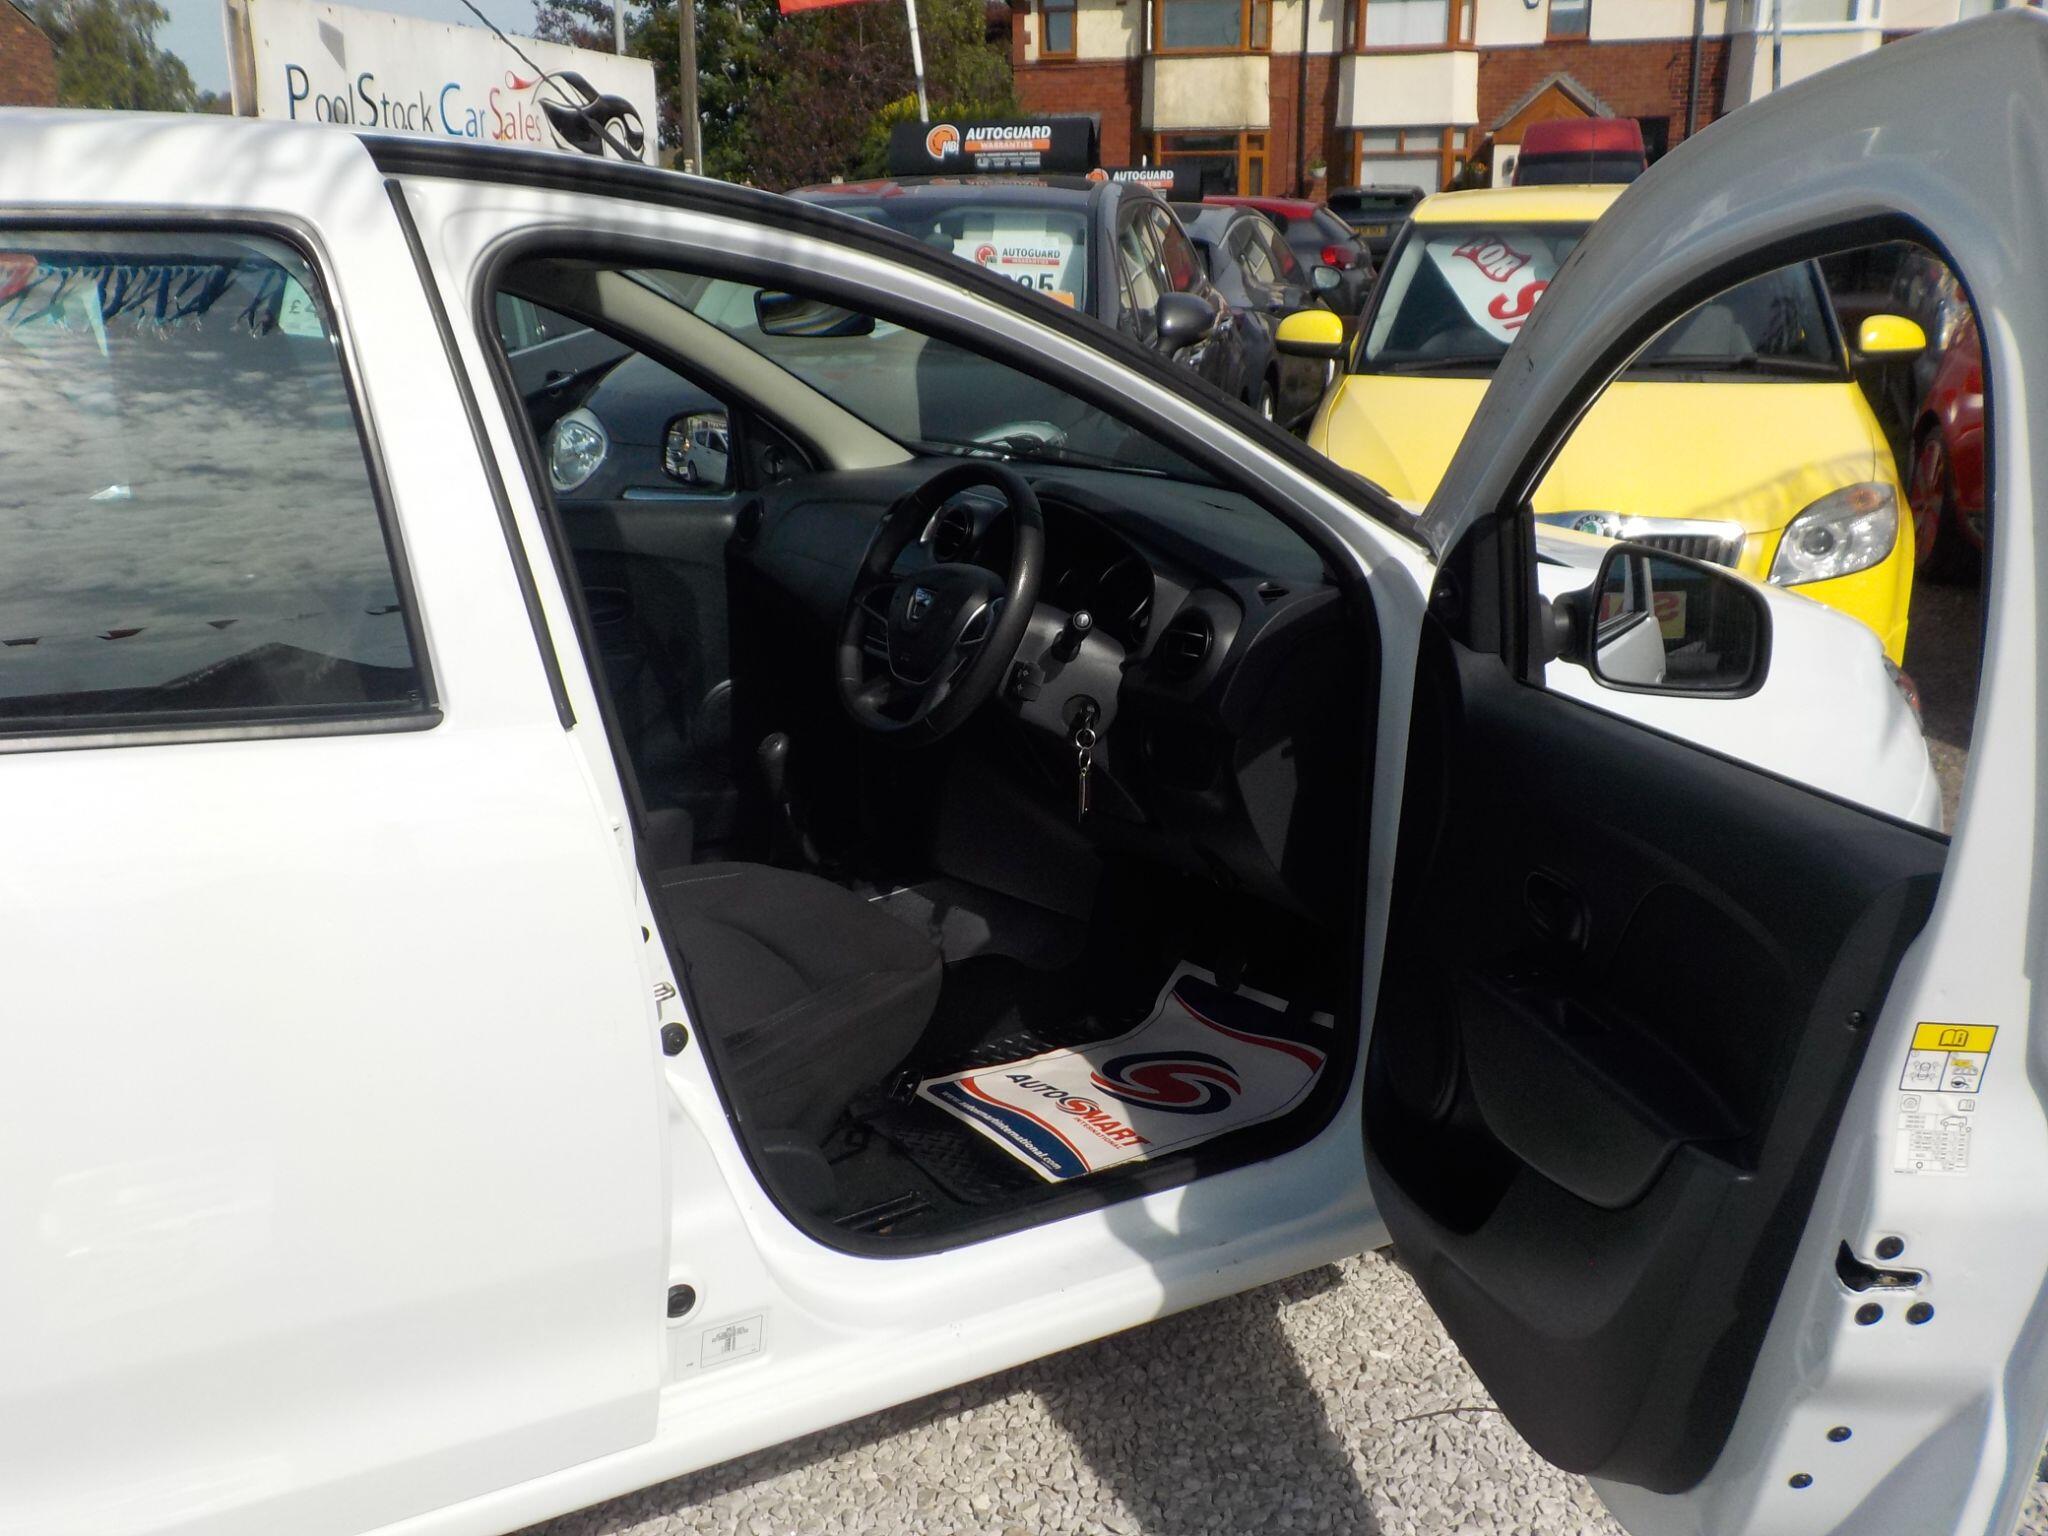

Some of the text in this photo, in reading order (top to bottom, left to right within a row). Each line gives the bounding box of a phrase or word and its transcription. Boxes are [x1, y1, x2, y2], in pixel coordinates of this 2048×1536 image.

[439, 82, 485, 138] Car
[489, 87, 542, 142] Sales
[965, 125, 1052, 140] AUTOGUARD
[979, 140, 1034, 150] WARRANTIES
[1113, 169, 1175, 182] AUTOGUARD
[1002, 247, 1061, 259] AUTOGUARD
